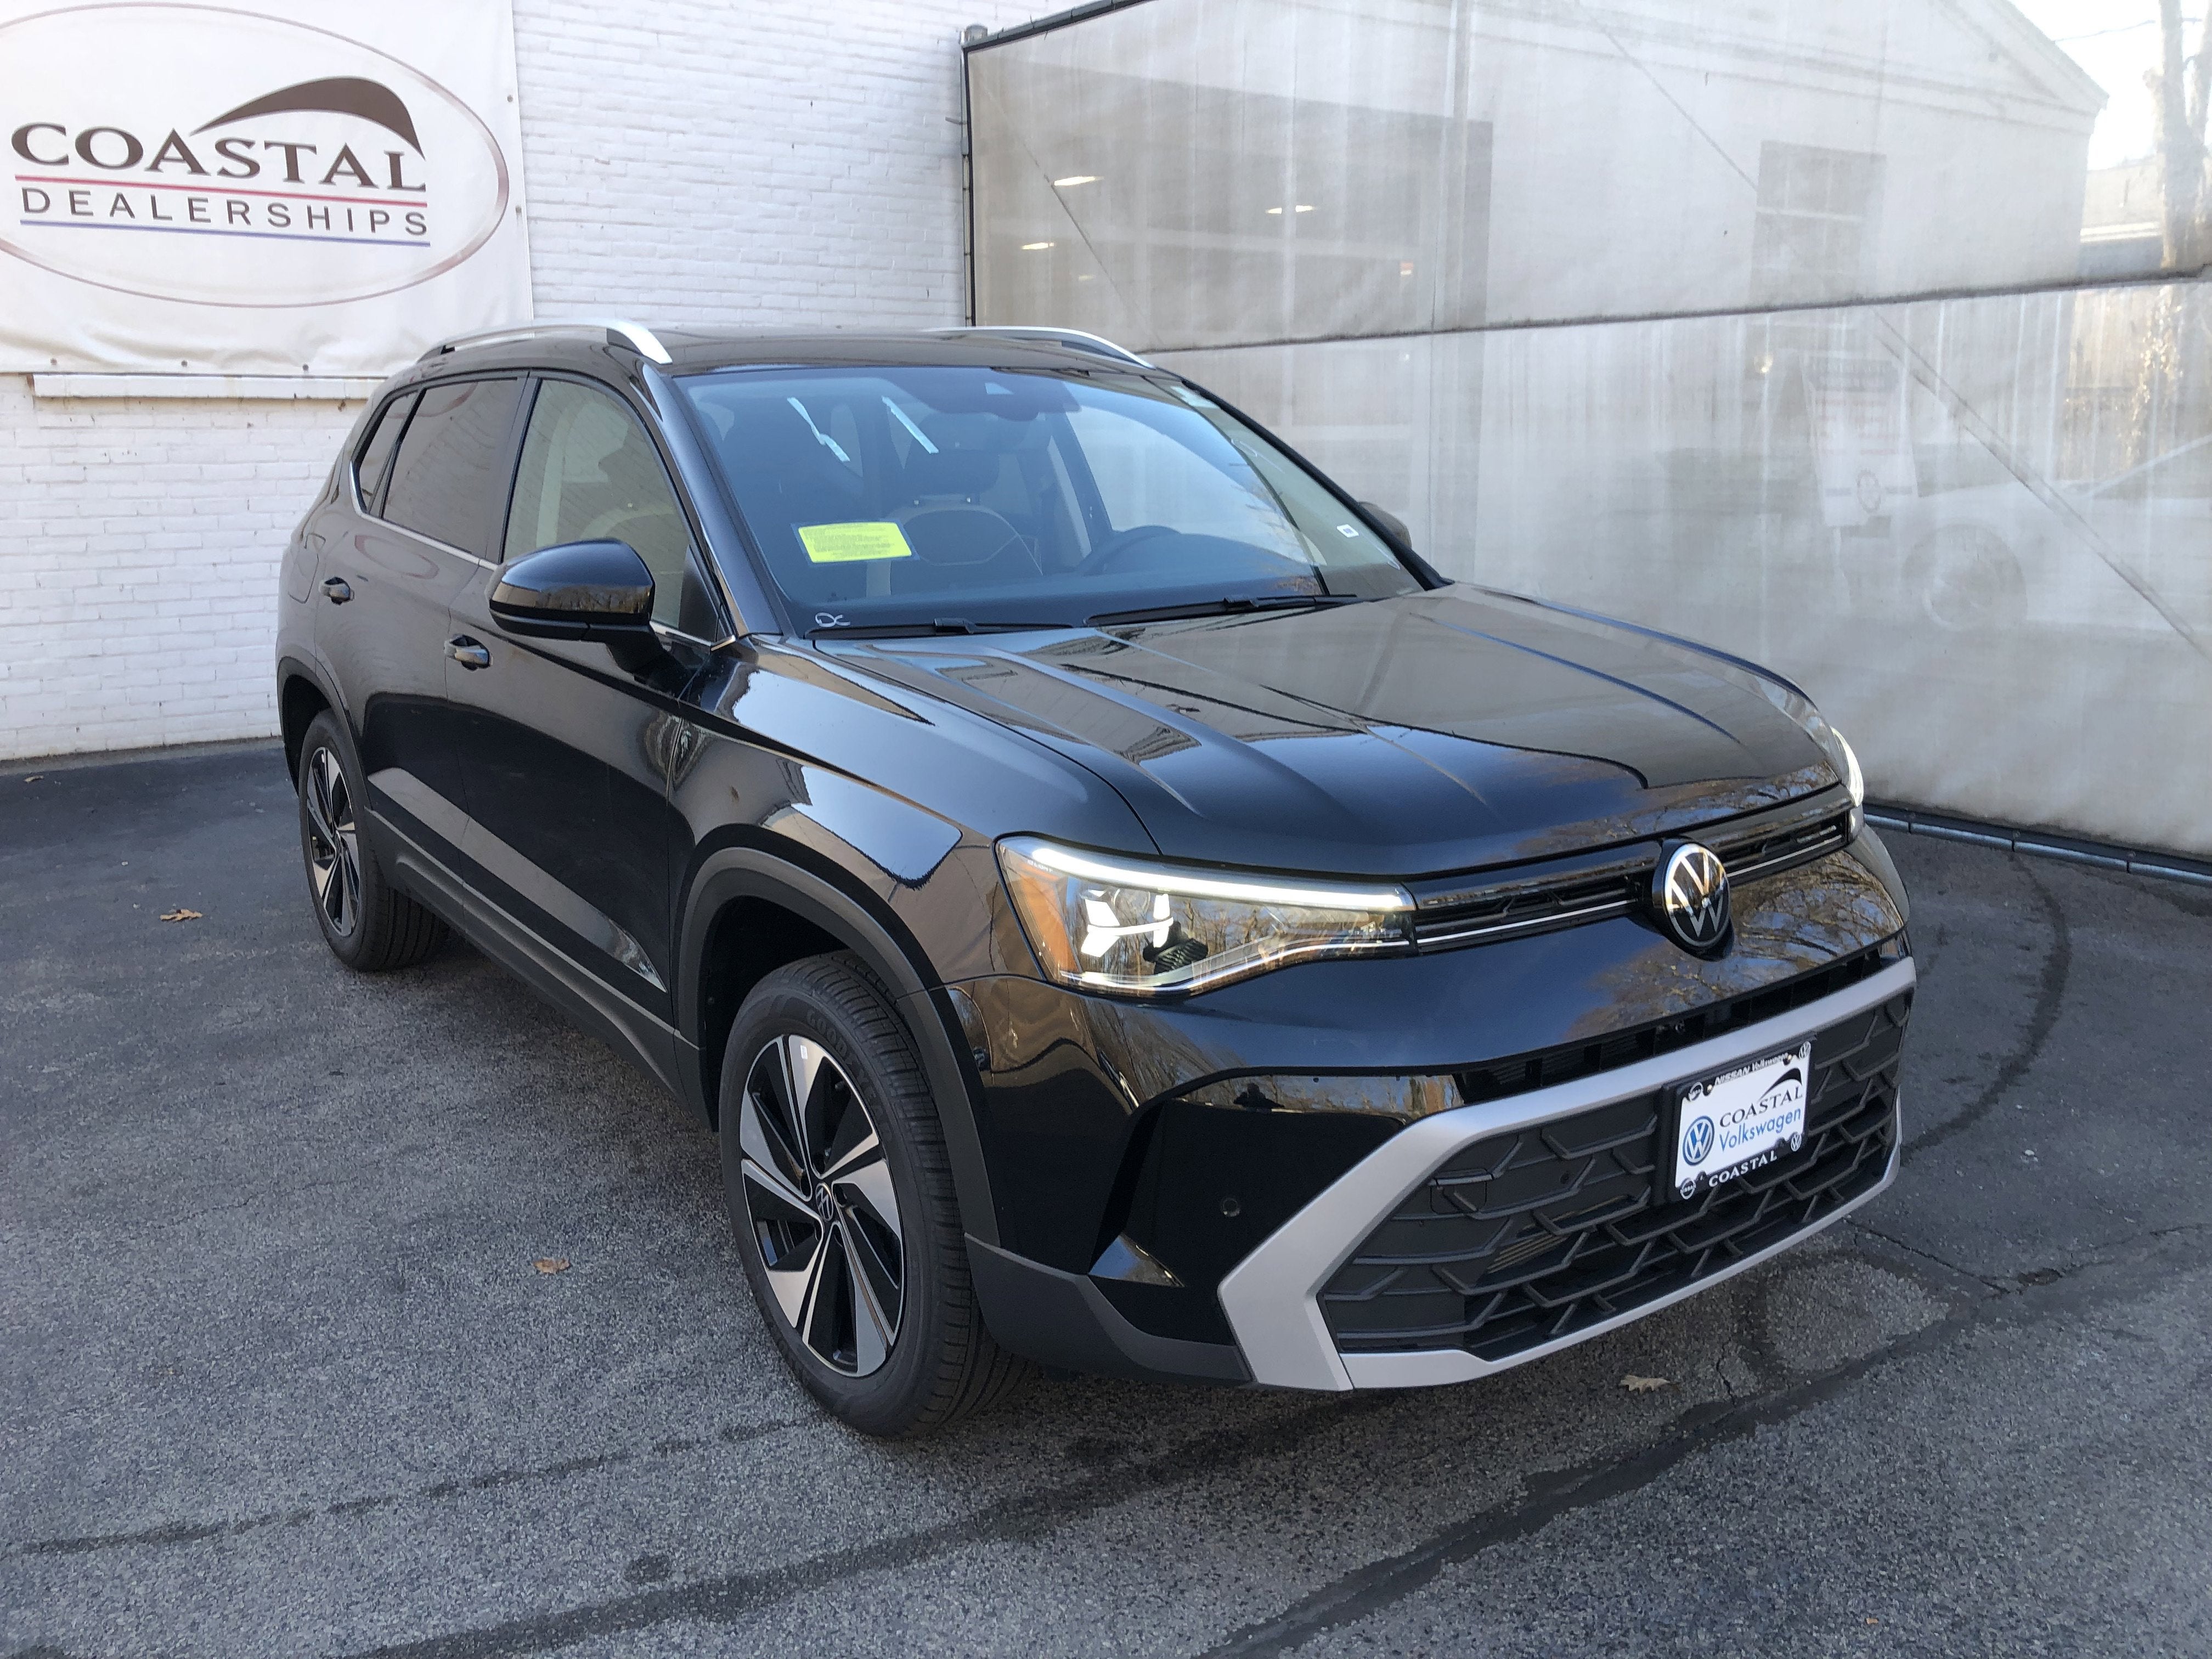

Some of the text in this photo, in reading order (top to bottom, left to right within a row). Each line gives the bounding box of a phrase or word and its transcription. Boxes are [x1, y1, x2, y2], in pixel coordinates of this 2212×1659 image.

[11, 122, 426, 193] COASTAL
[21, 187, 428, 235] DEALERSHIPS
[1719, 1086, 1803, 1127] COASTAL
[1719, 1108, 1801, 1152] Volkswagen
[1708, 1150, 1778, 1187] COASTAL
